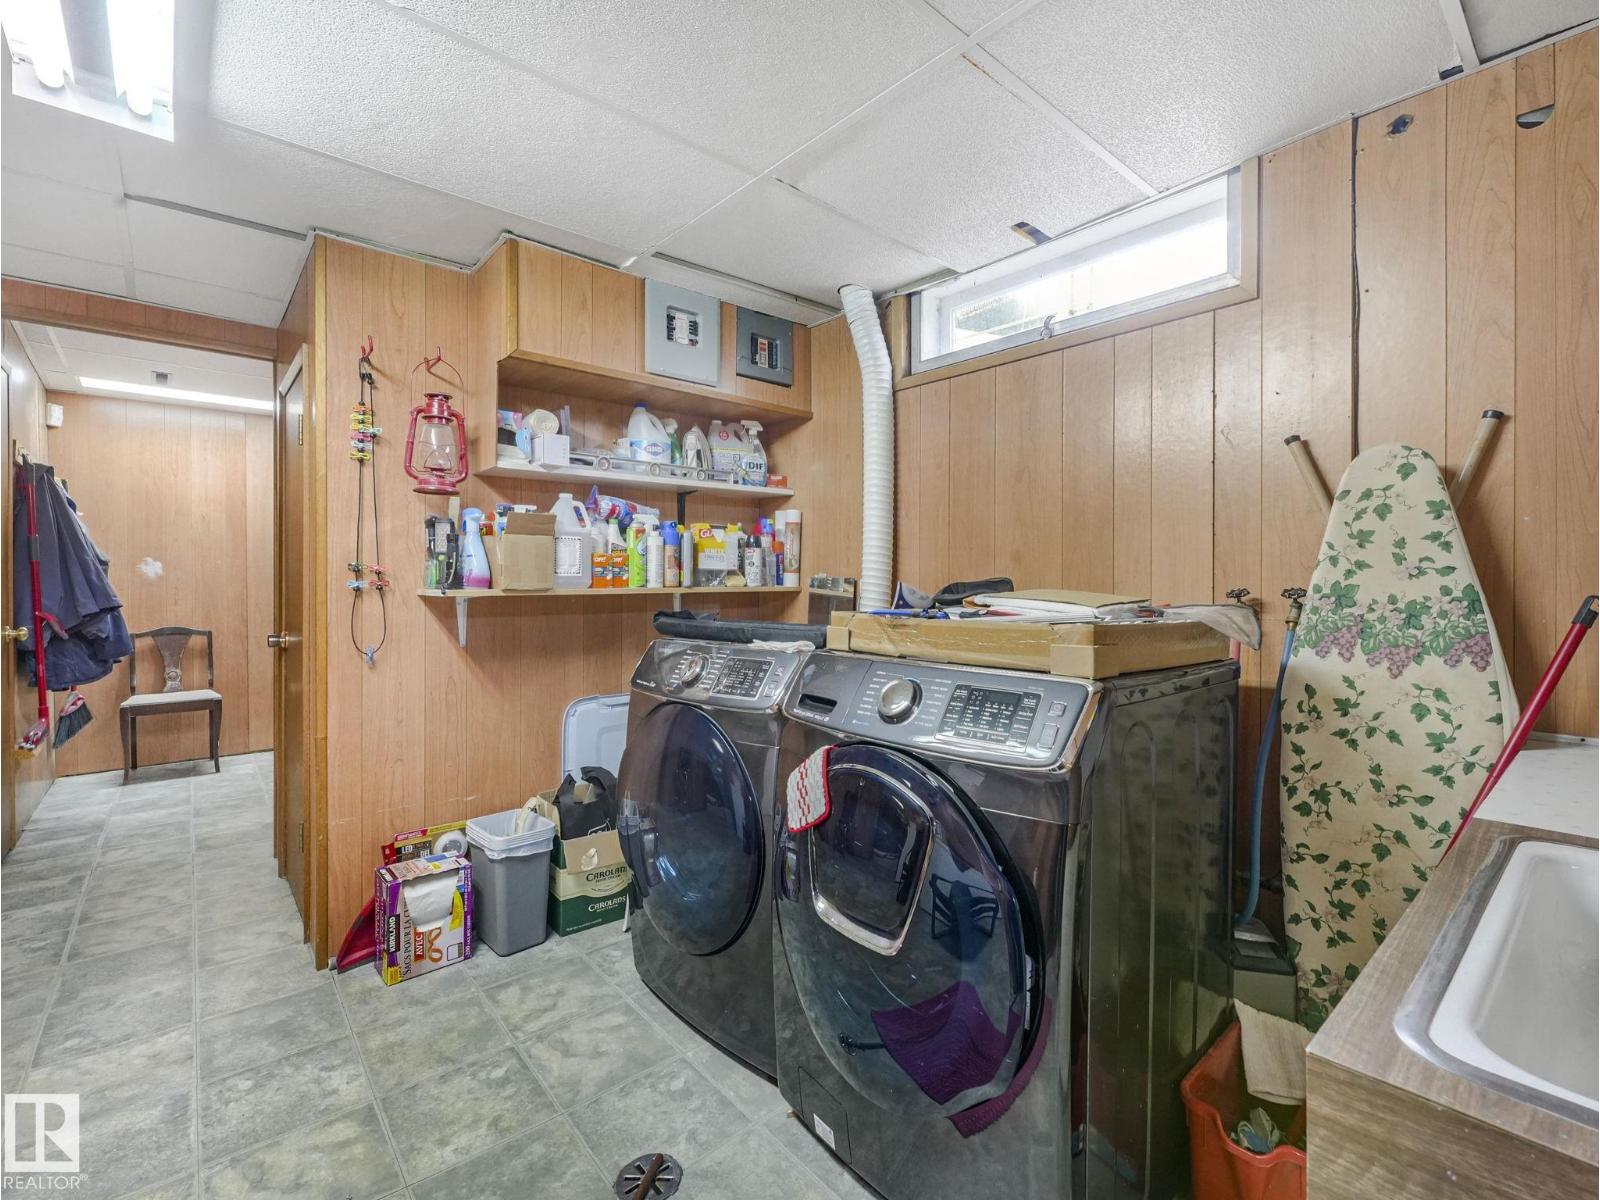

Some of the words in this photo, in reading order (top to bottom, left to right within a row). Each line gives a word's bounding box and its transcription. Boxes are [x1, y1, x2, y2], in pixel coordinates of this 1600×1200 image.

[748, 462, 764, 471] DIF
[401, 845, 413, 854] LED
[588, 895, 626, 912] CAROLANS
[403, 930, 412, 953] POUR
[415, 934, 423, 956] AVEC
[403, 955, 412, 976] SACS
